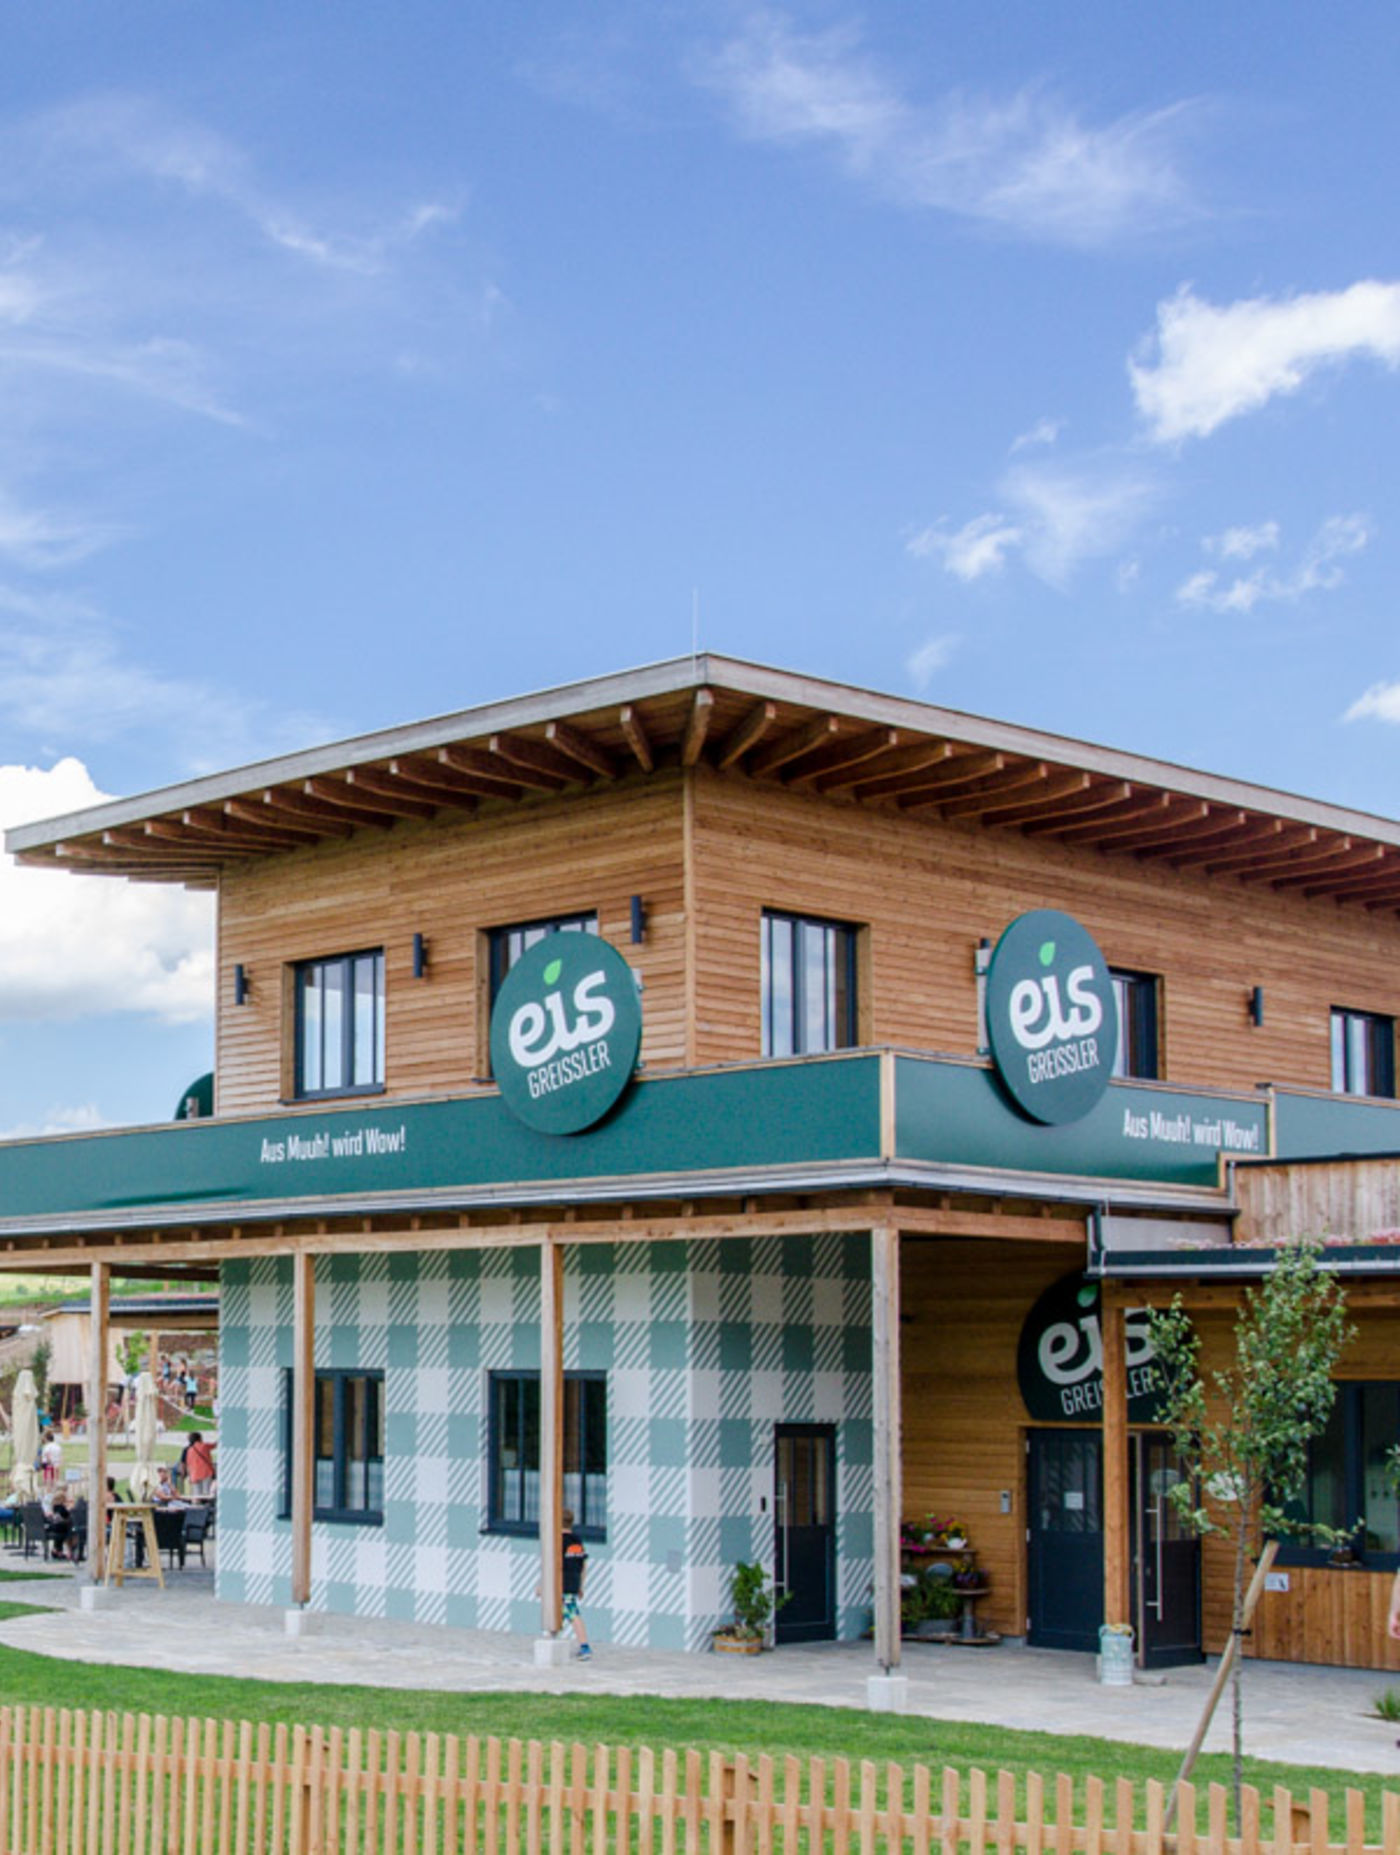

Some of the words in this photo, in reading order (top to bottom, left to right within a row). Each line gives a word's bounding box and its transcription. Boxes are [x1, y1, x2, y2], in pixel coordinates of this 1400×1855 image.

[508, 958, 615, 1067] eis
[1009, 941, 1102, 1049] eis
[527, 1040, 611, 1099] GREISSLER
[1027, 1038, 1099, 1084] GREISSLER
[260, 1138, 285, 1163] Aus
[287, 1133, 330, 1160] Muuh!
[331, 1131, 363, 1157] wird
[365, 1124, 406, 1155] Wow!
[1123, 1108, 1148, 1139] Aus
[1150, 1110, 1191, 1143] Muuh!
[1192, 1117, 1221, 1147] wird
[1222, 1119, 1259, 1151] Wow!
[1060, 1366, 1154, 1415] GREIER
